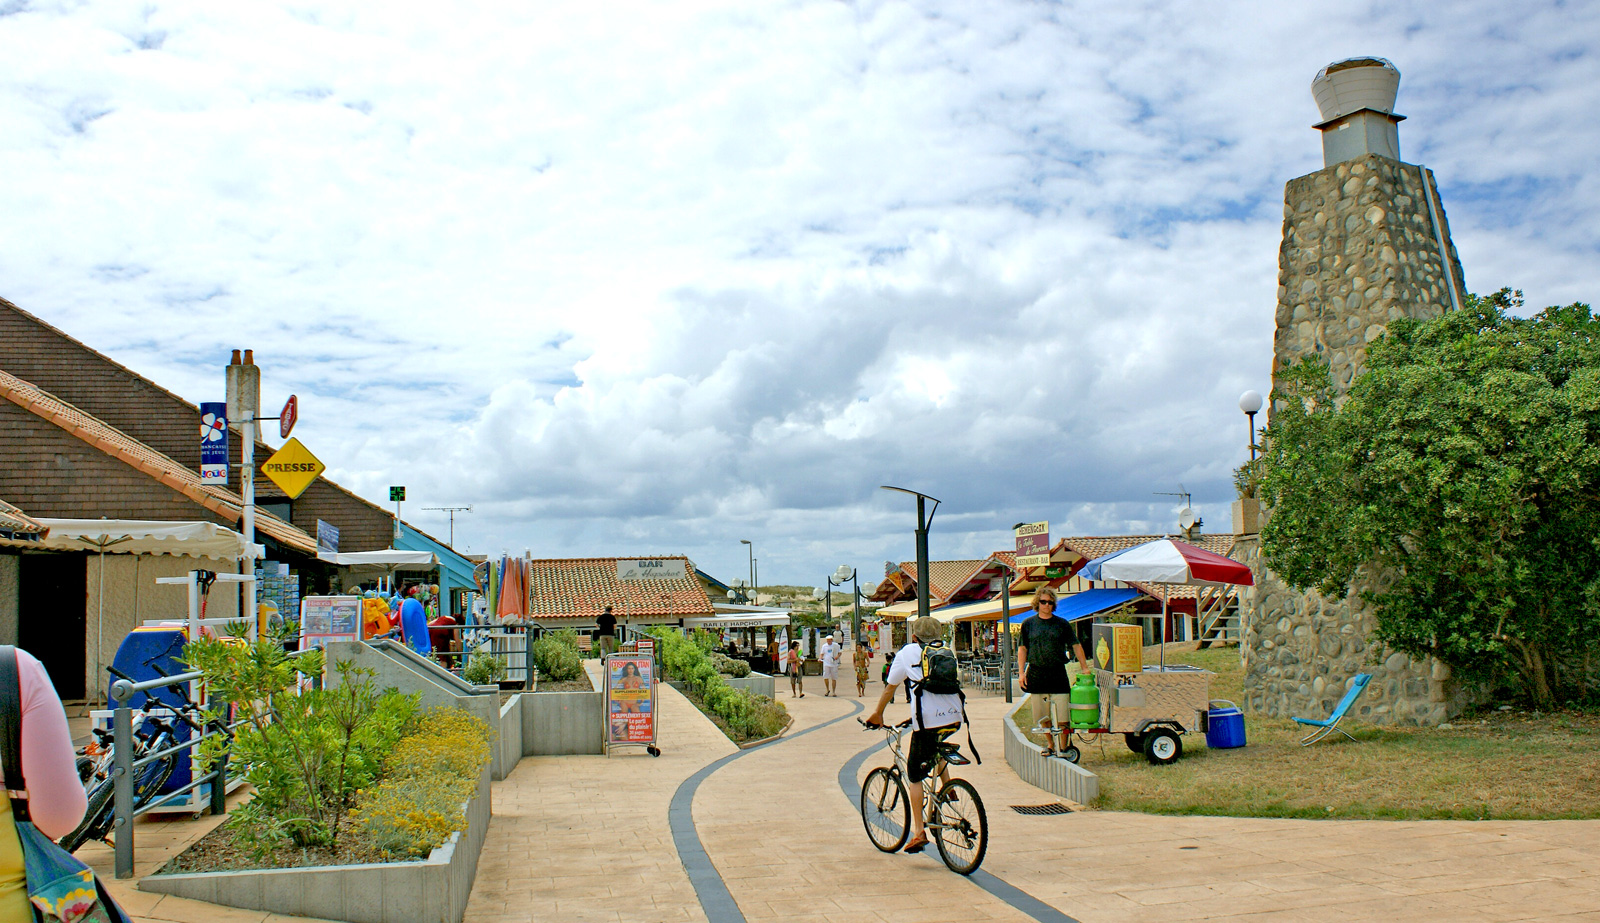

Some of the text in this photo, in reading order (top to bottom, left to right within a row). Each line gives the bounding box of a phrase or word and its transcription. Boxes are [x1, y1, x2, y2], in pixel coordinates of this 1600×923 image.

[282, 403, 294, 430] TABAC
[266, 463, 316, 472] PRESSE
[201, 470, 226, 478] LOTO
[639, 560, 663, 568] BAR
